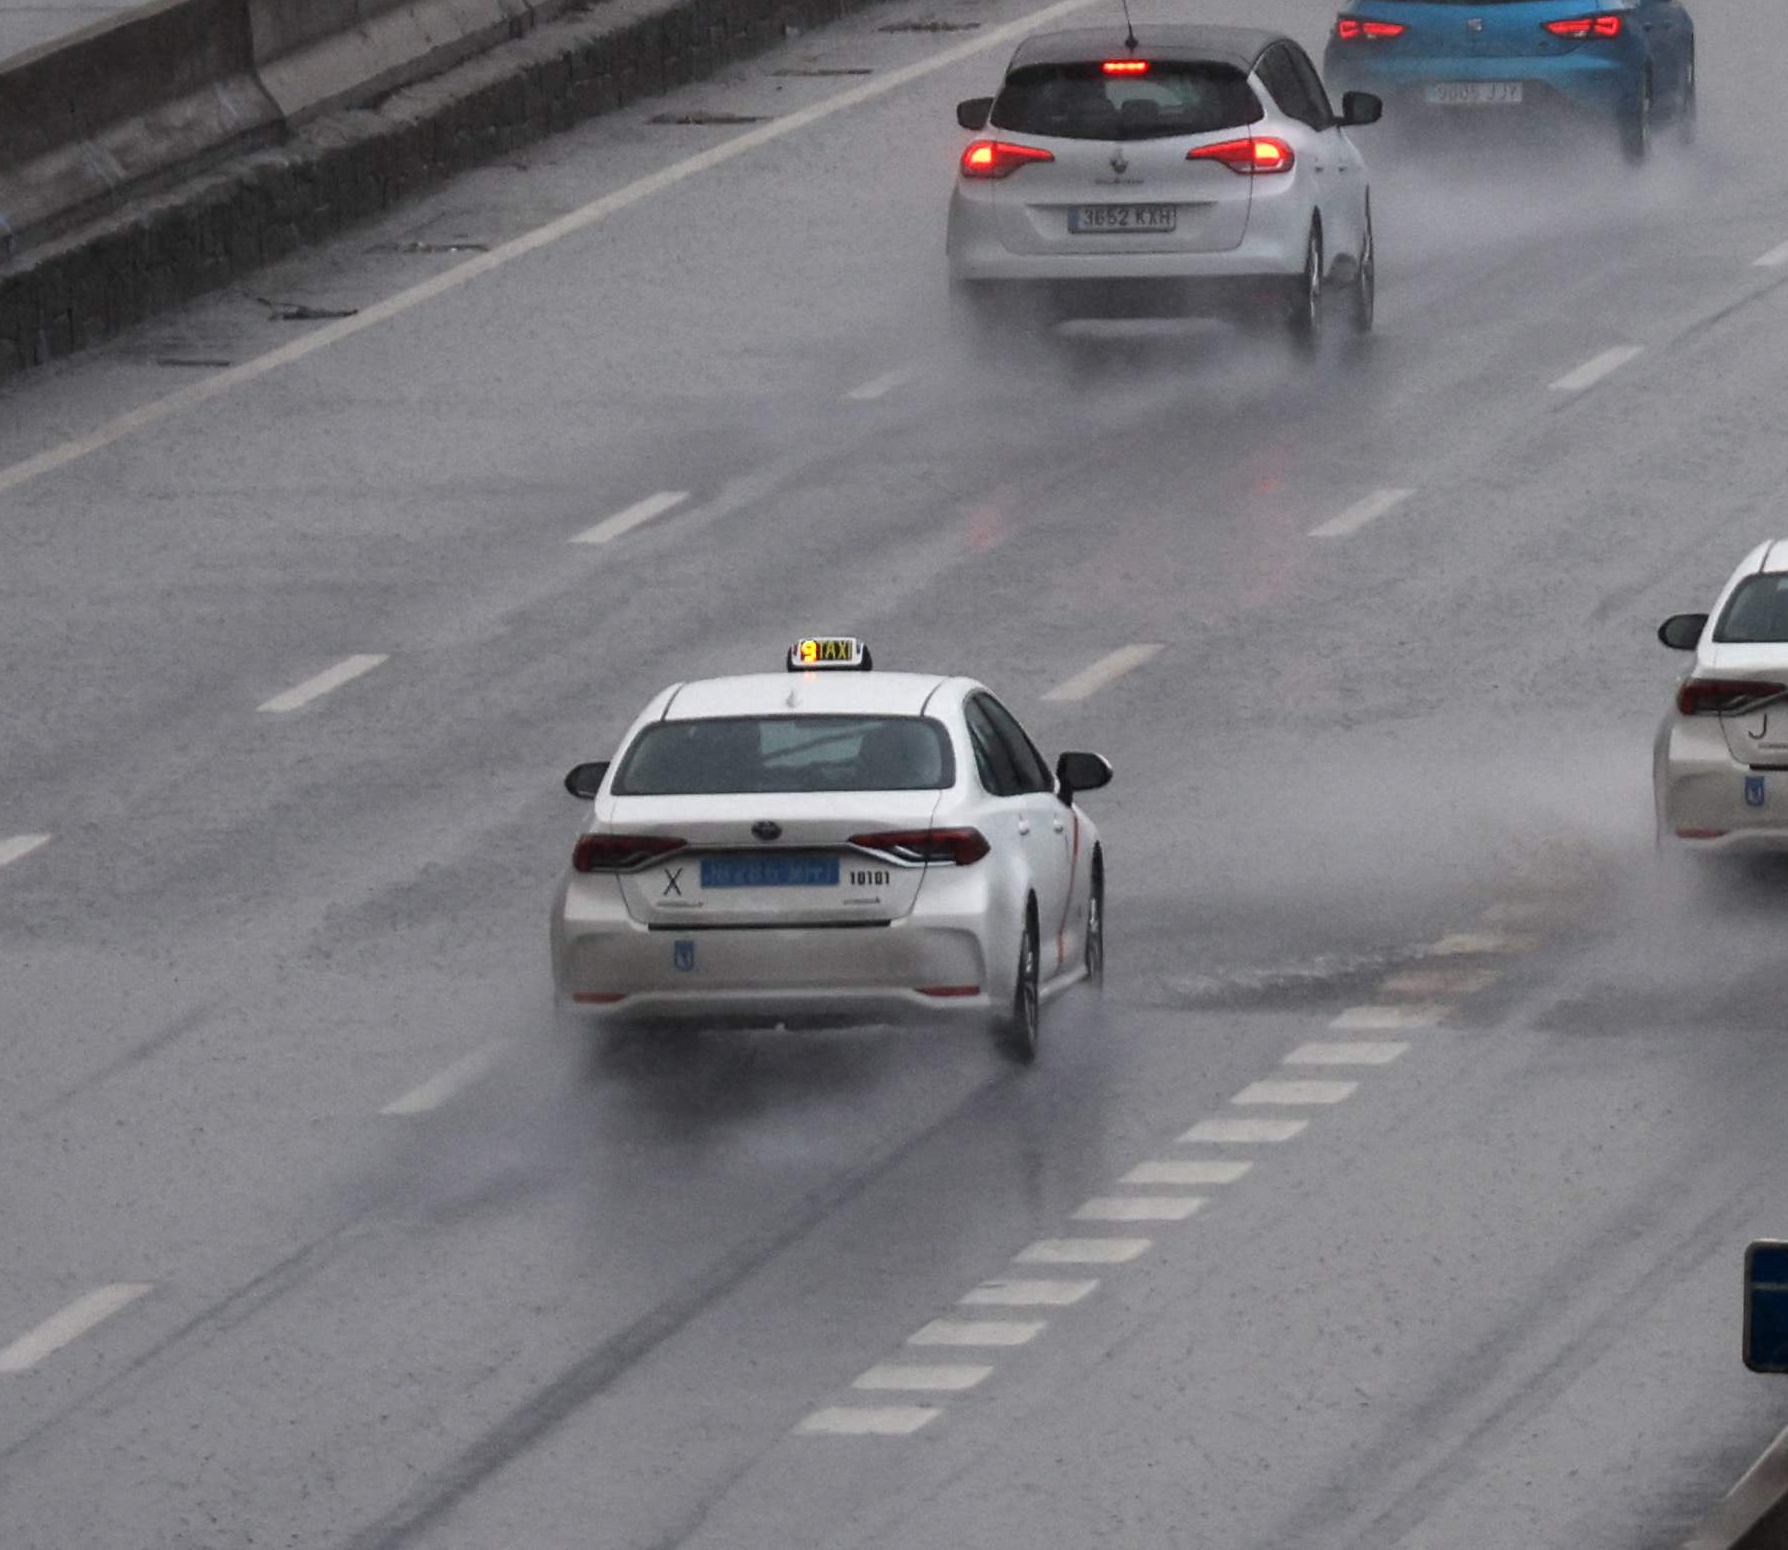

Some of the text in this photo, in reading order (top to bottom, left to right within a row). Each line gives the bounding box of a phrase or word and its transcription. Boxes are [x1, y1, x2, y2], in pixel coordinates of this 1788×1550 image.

[818, 640, 852, 661] TAXI
[665, 868, 684, 896] X
[850, 870, 890, 886] 10101
